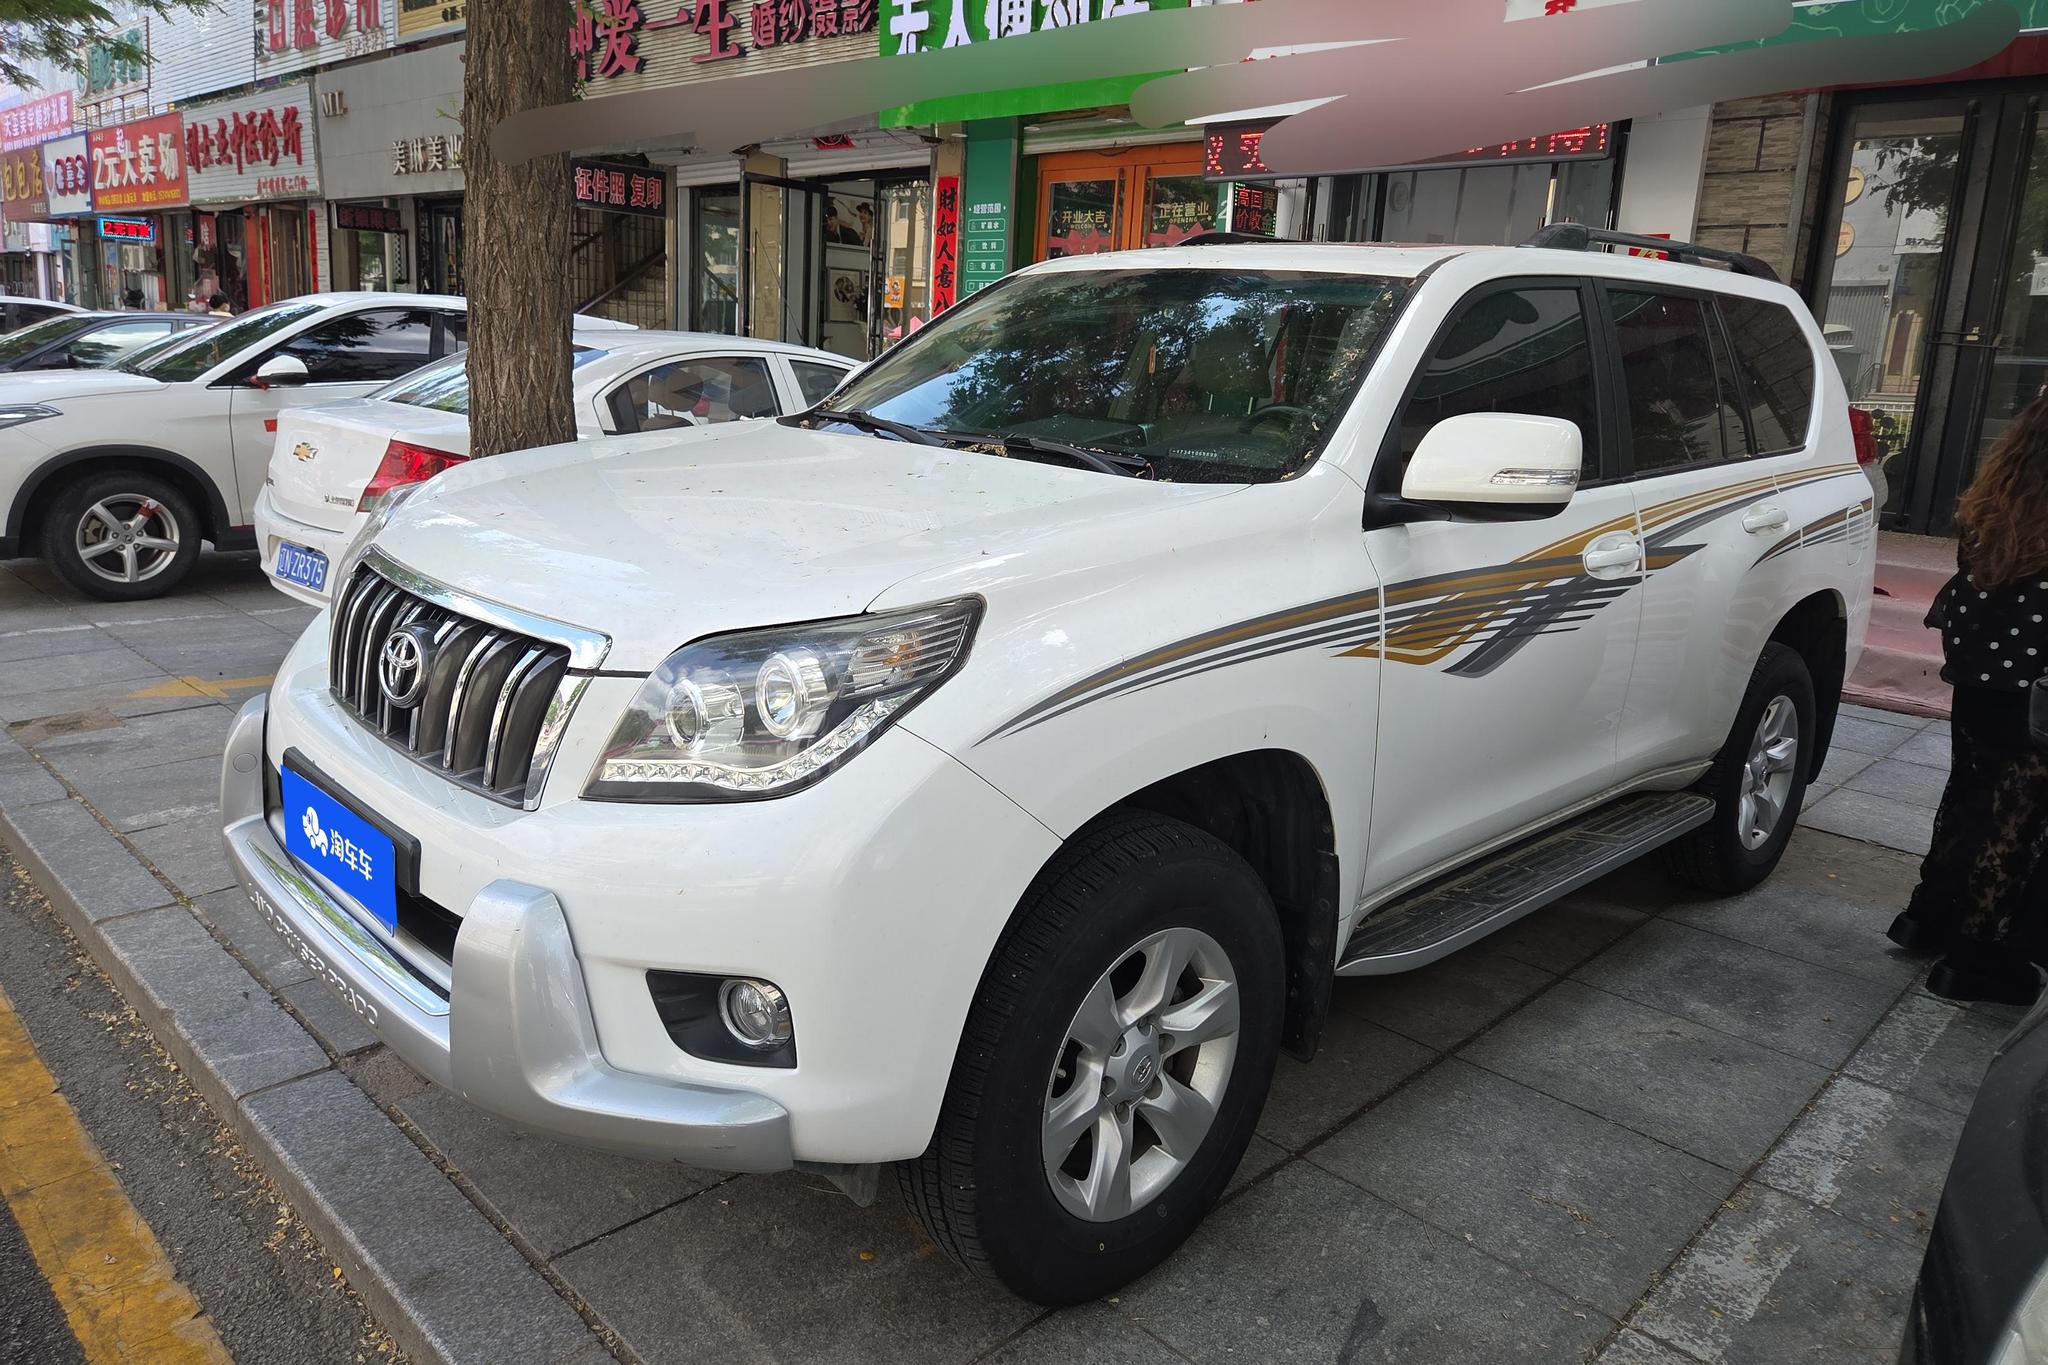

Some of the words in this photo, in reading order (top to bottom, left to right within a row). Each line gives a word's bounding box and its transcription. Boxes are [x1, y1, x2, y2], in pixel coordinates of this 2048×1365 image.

[574, 167, 625, 205] 证件照
[630, 174, 662, 209] 复印
[1062, 210, 1106, 223] 开业大吉
[1160, 201, 1209, 218] 正在营业
